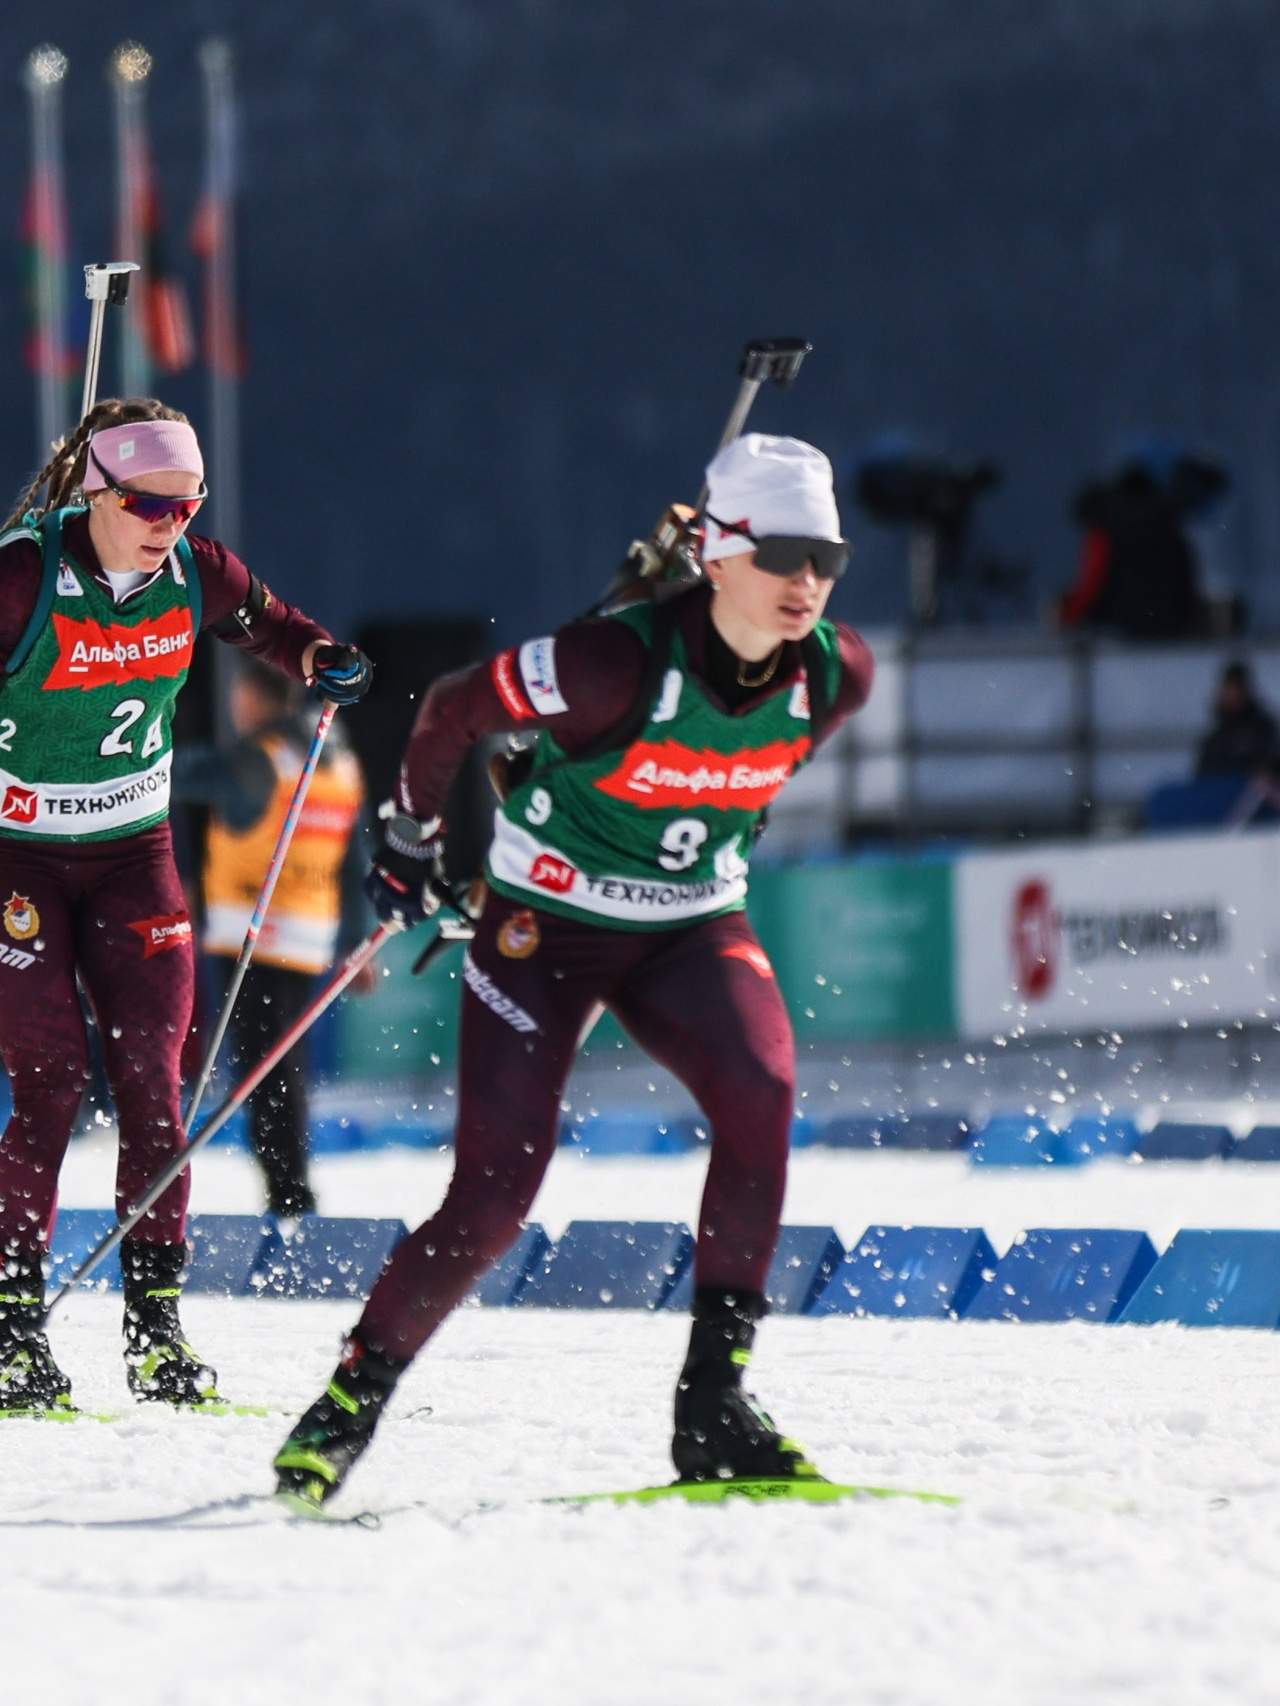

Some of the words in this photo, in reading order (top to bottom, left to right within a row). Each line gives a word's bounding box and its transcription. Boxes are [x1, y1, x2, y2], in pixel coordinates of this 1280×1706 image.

[69, 640, 141, 672] Альфа
[143, 630, 191, 658] Банк
[98, 697, 147, 758] 2
[44, 770, 168, 815] ТЕХНОНИКОЛЬ
[627, 760, 727, 794] Альфа
[728, 763, 789, 790] Банк
[524, 788, 552, 827] 9
[657, 817, 710, 872] 9
